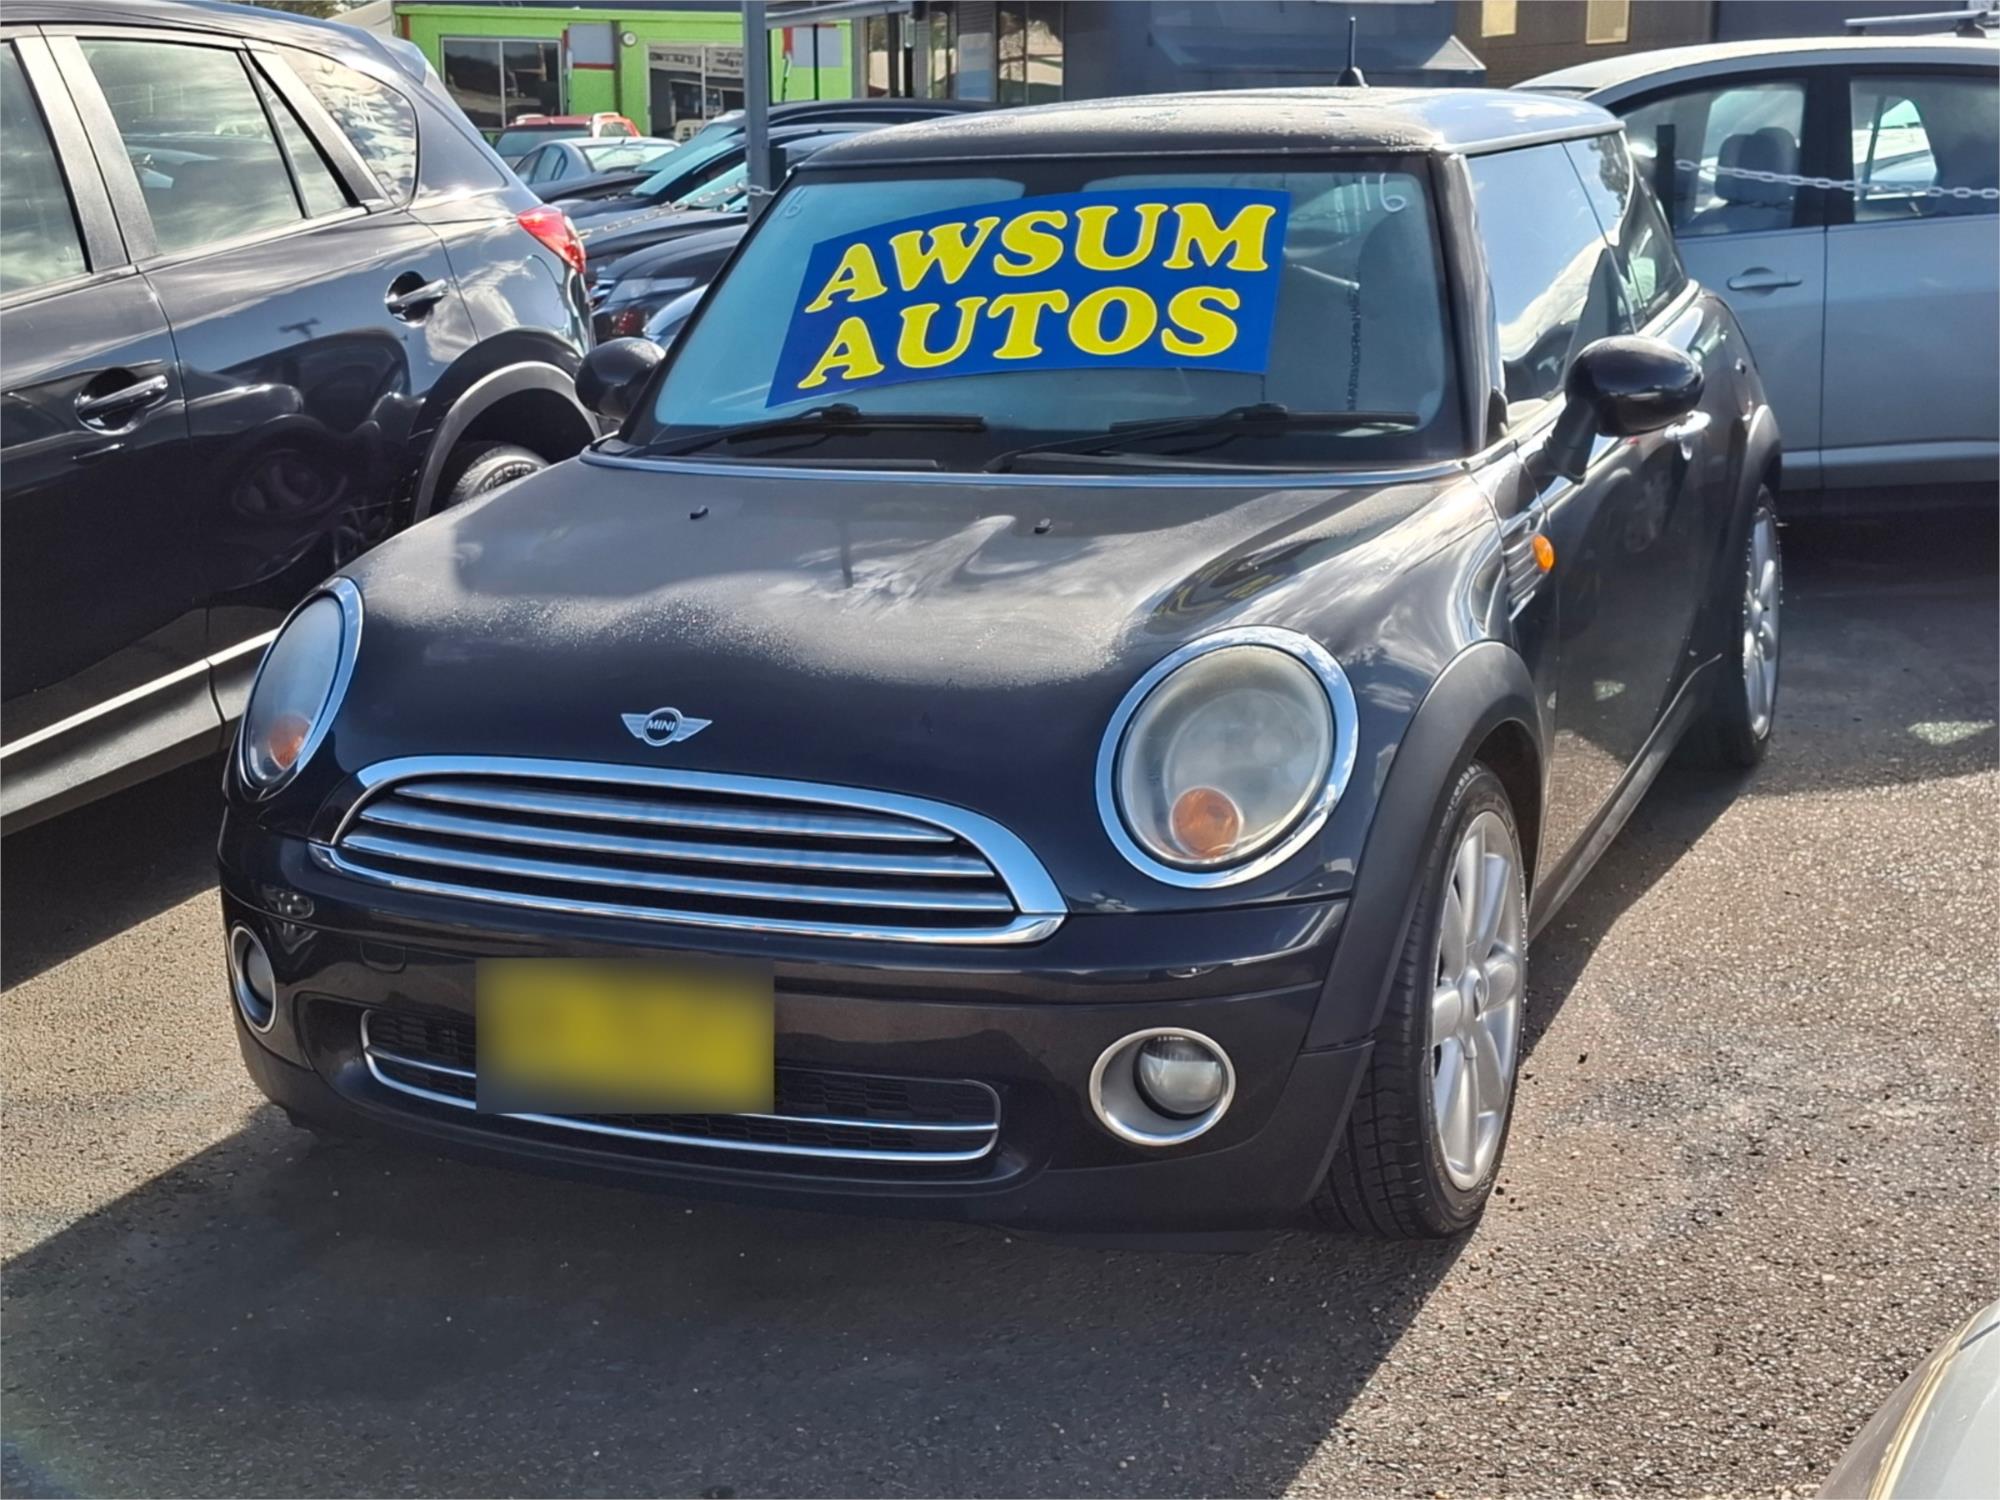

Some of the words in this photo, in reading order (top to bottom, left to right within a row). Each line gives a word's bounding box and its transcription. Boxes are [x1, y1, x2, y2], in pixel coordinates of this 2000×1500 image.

[1361, 172, 1407, 212] 16
[803, 202, 1277, 314] AWSUM
[797, 286, 1241, 389] AUTOS
[646, 719, 677, 732] MINI
